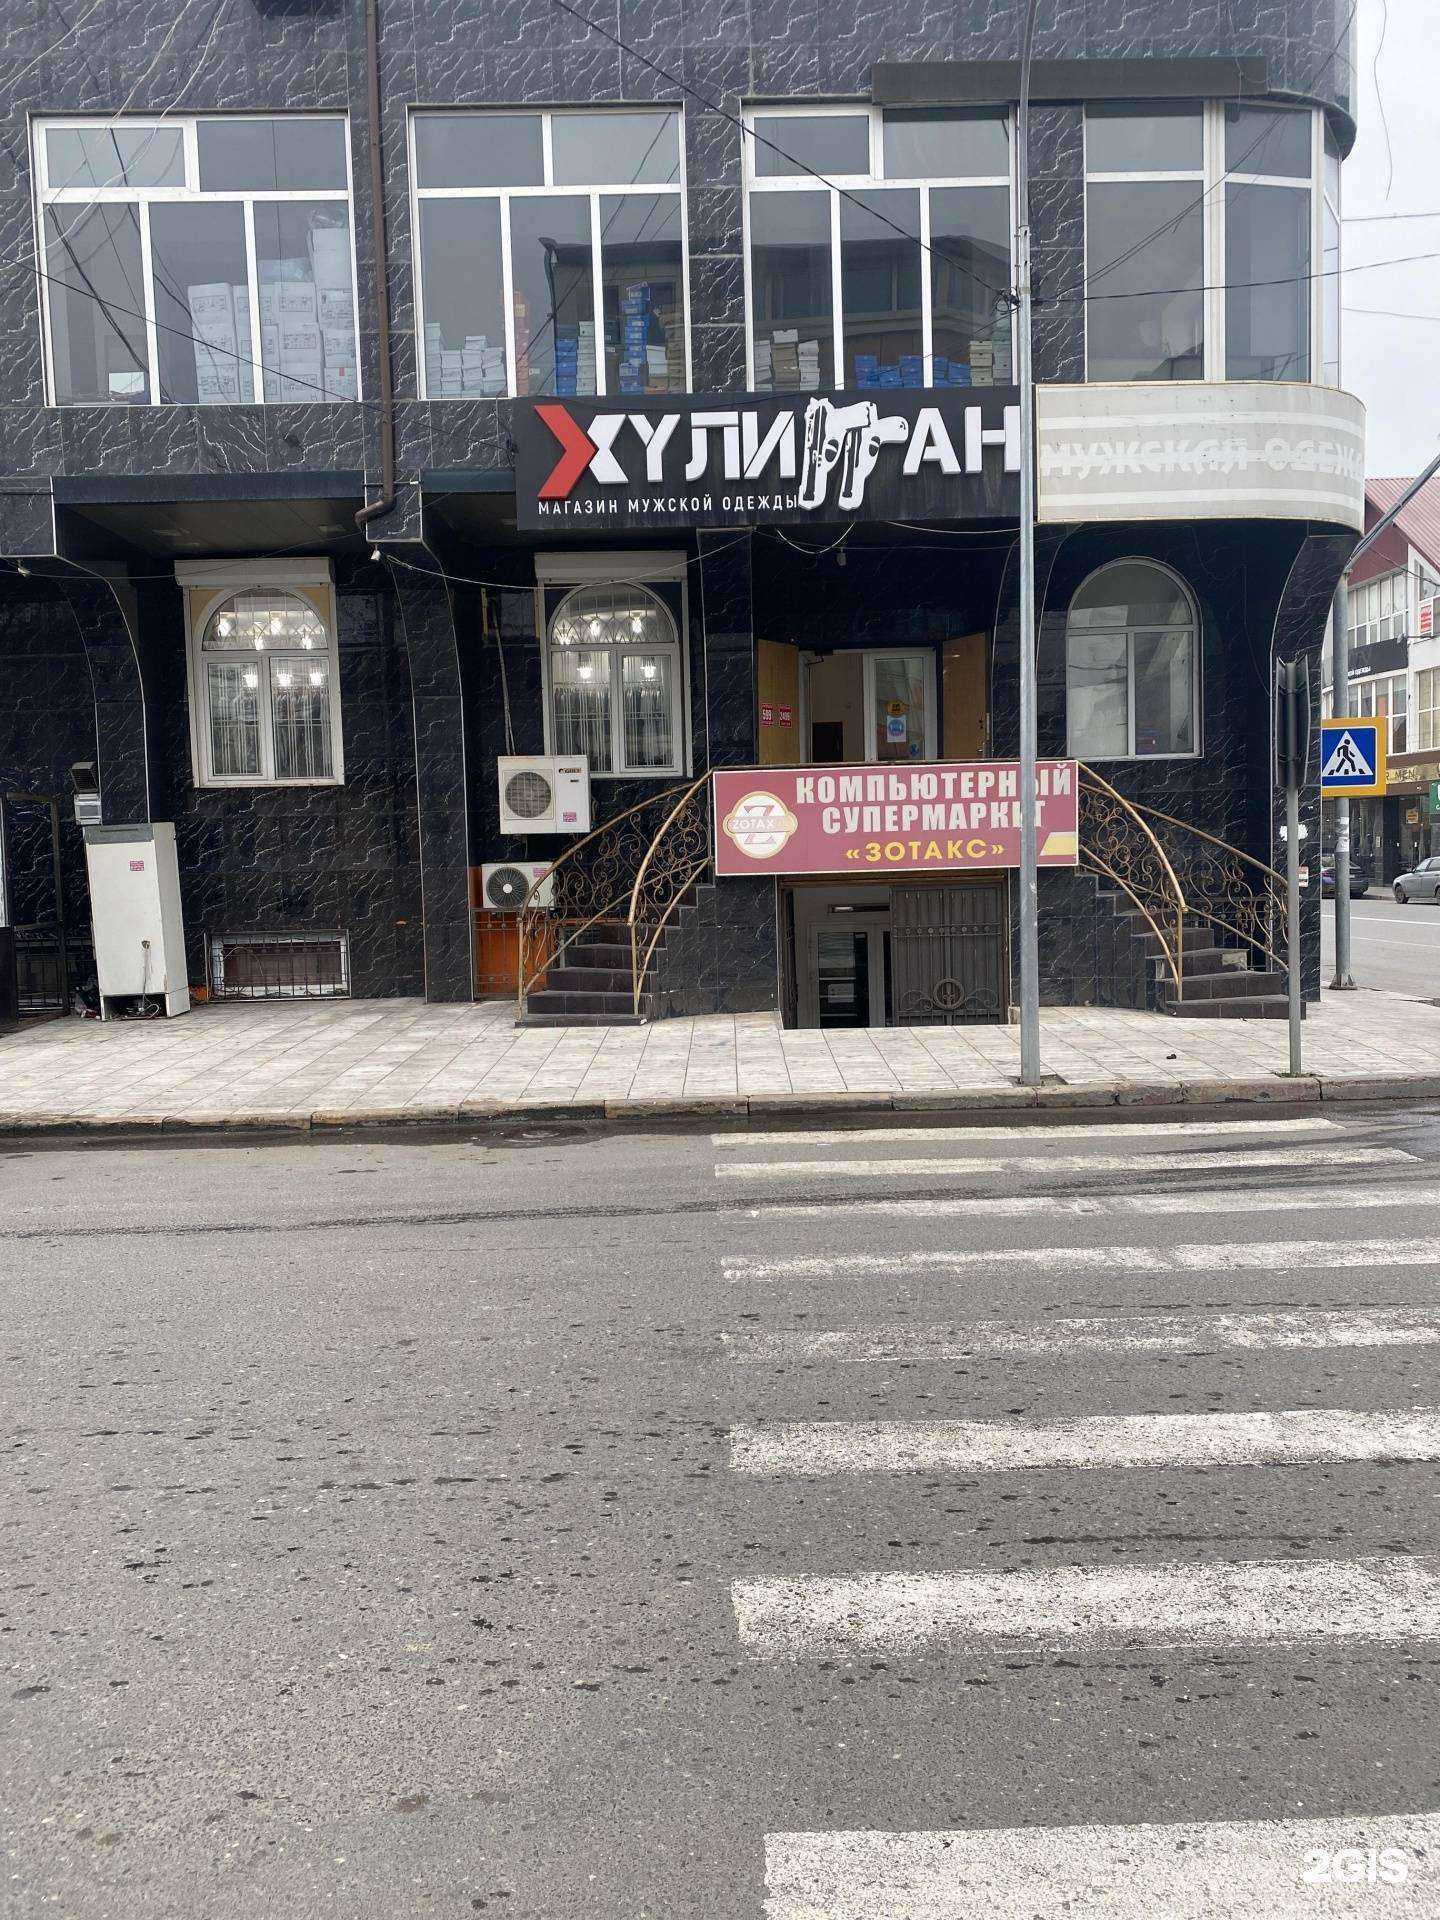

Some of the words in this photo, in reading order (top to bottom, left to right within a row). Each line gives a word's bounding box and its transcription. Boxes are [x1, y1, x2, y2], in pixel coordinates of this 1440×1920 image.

[538, 500, 618, 515] МАГАЗИН
[628, 493, 713, 513] МУЖСКОЙ
[722, 495, 797, 512] ОДЕЖДЫ
[846, 838, 1005, 862] «ЗОТАКС»
